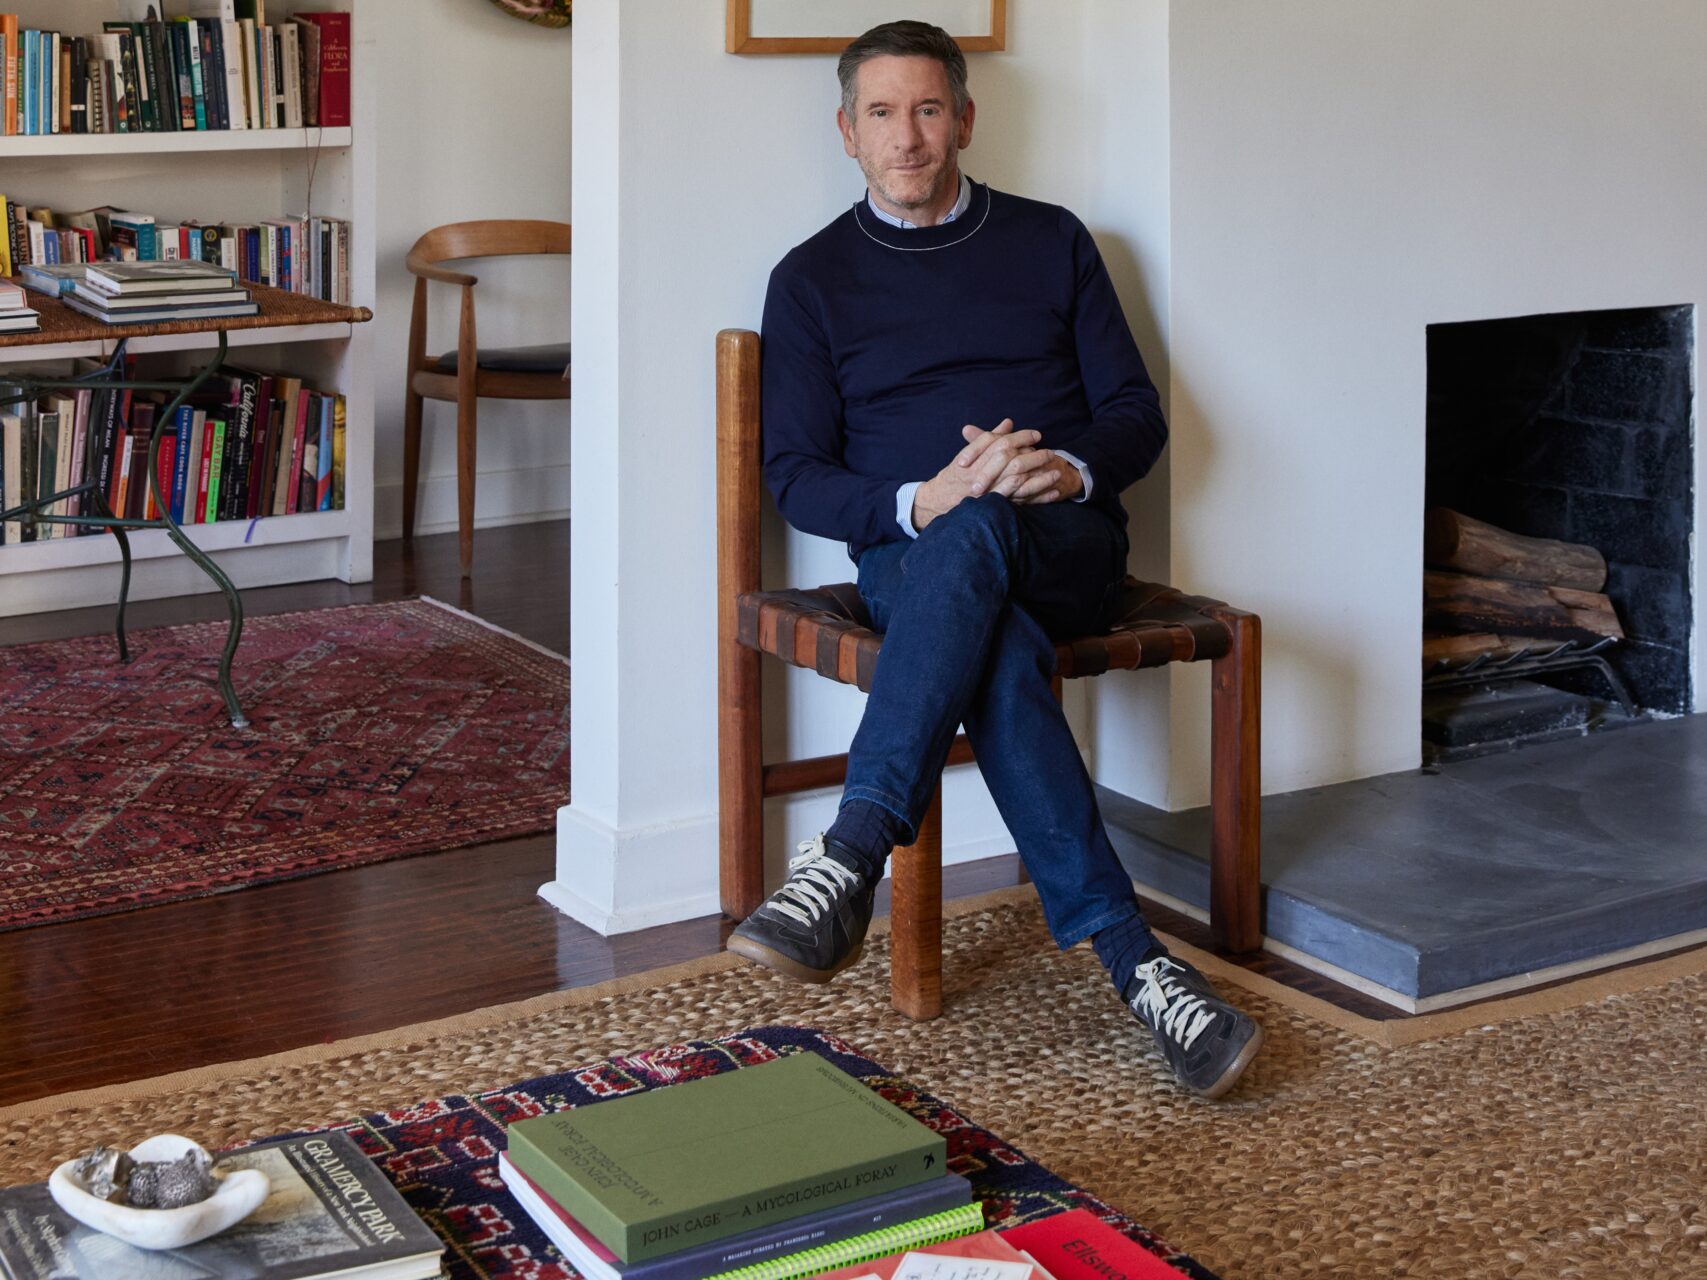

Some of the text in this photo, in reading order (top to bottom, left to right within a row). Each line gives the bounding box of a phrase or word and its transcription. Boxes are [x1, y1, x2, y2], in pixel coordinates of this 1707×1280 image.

[7, 56, 16, 98] FIFTH SUN
[323, 52, 348, 60] FLORA
[17, 218, 29, 265] JB BLUN
[107, 389, 117, 419] NTRYWAYS
[107, 420, 113, 429] OF
[239, 383, 256, 439] California
[104, 429, 112, 448] MILAN
[212, 435, 224, 479] GAY BAR
[303, 1139, 406, 1245] GRAMERCY PARK
[643, 1164, 898, 1247] JOHN CAGE A MYCOLOGICAL FORAY
